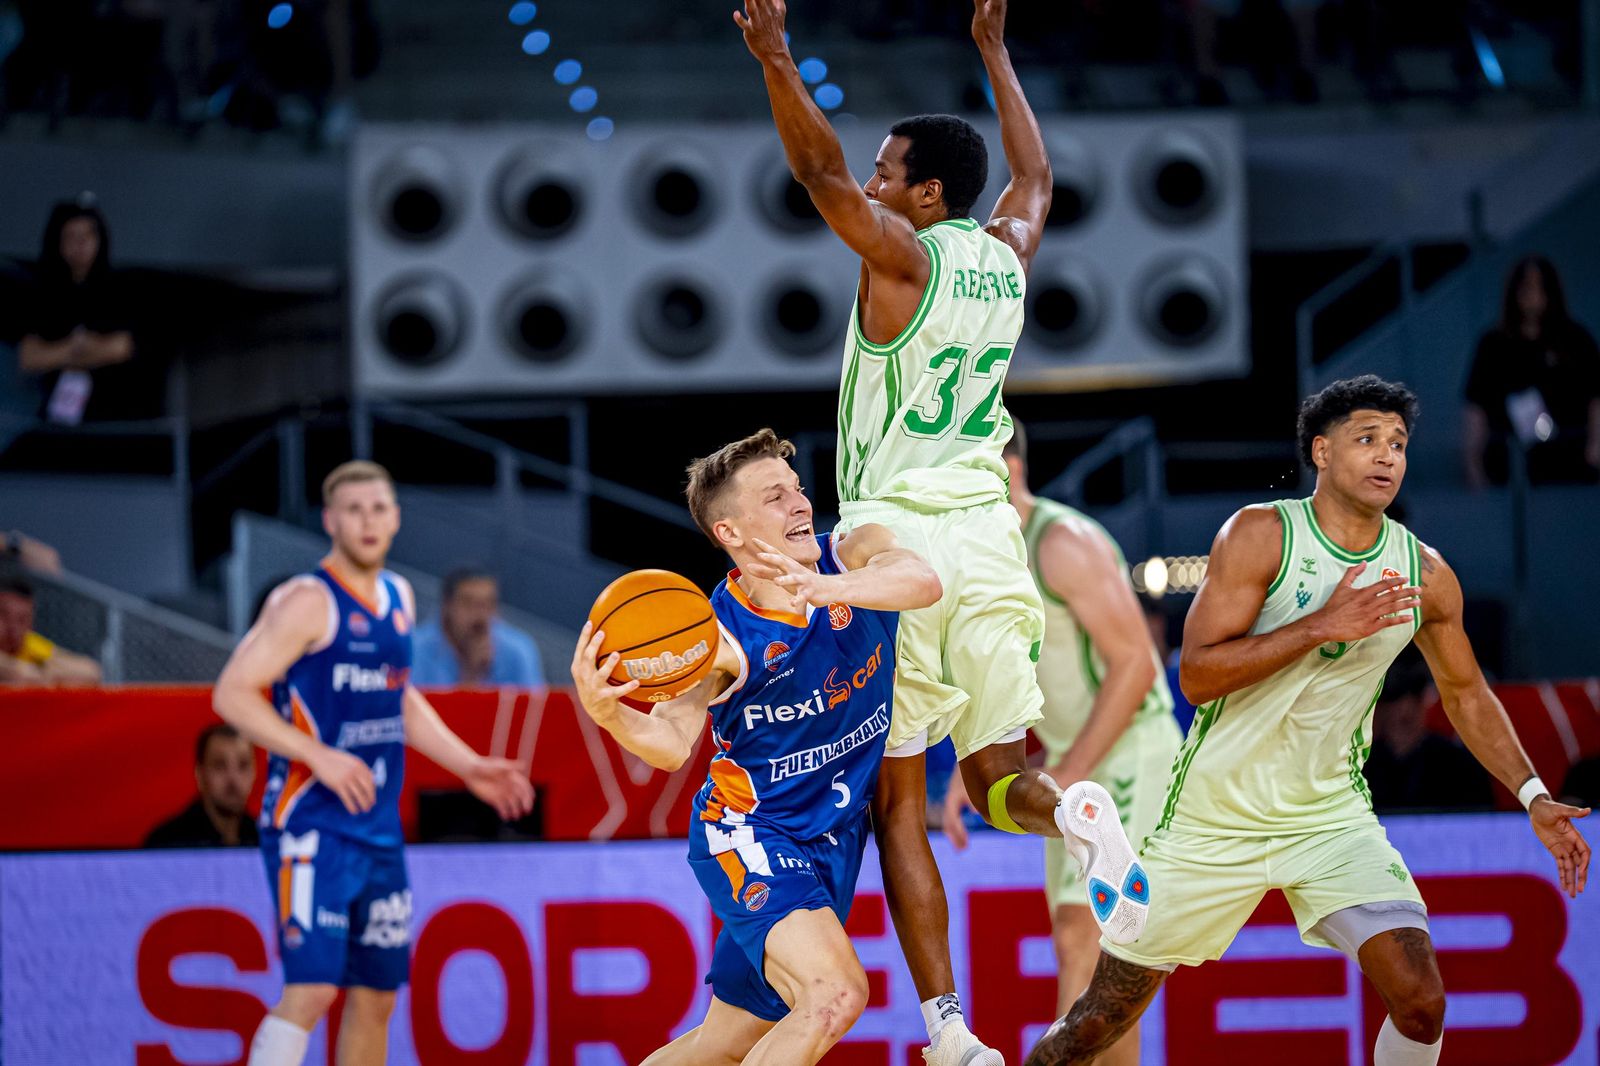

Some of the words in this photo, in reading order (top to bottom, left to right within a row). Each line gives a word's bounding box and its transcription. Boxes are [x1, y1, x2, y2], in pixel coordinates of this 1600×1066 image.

[902, 343, 1013, 440] 32
[622, 640, 709, 680] Wilson
[831, 769, 851, 809] 5
